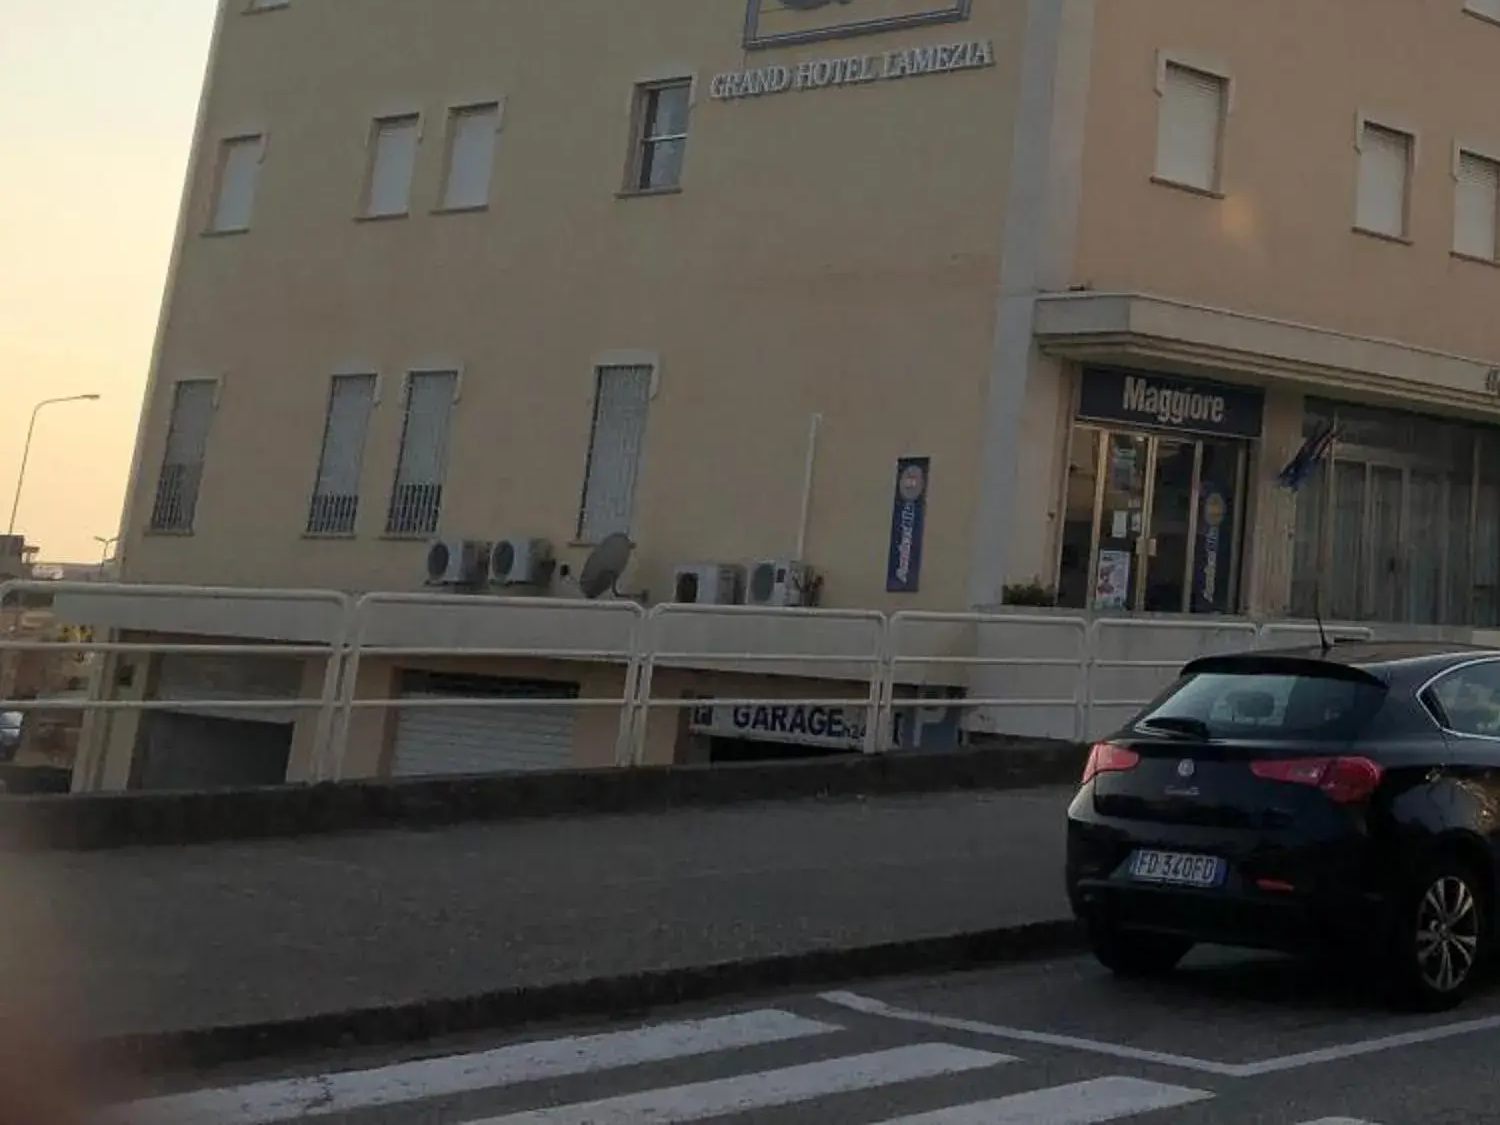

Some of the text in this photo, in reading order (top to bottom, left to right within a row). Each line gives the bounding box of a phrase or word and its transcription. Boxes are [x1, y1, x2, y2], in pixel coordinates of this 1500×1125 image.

[709, 40, 995, 99] GRAND HOTEL LAMEZIA
[1122, 375, 1225, 424] Maggiore
[732, 704, 845, 738] GARAGE
